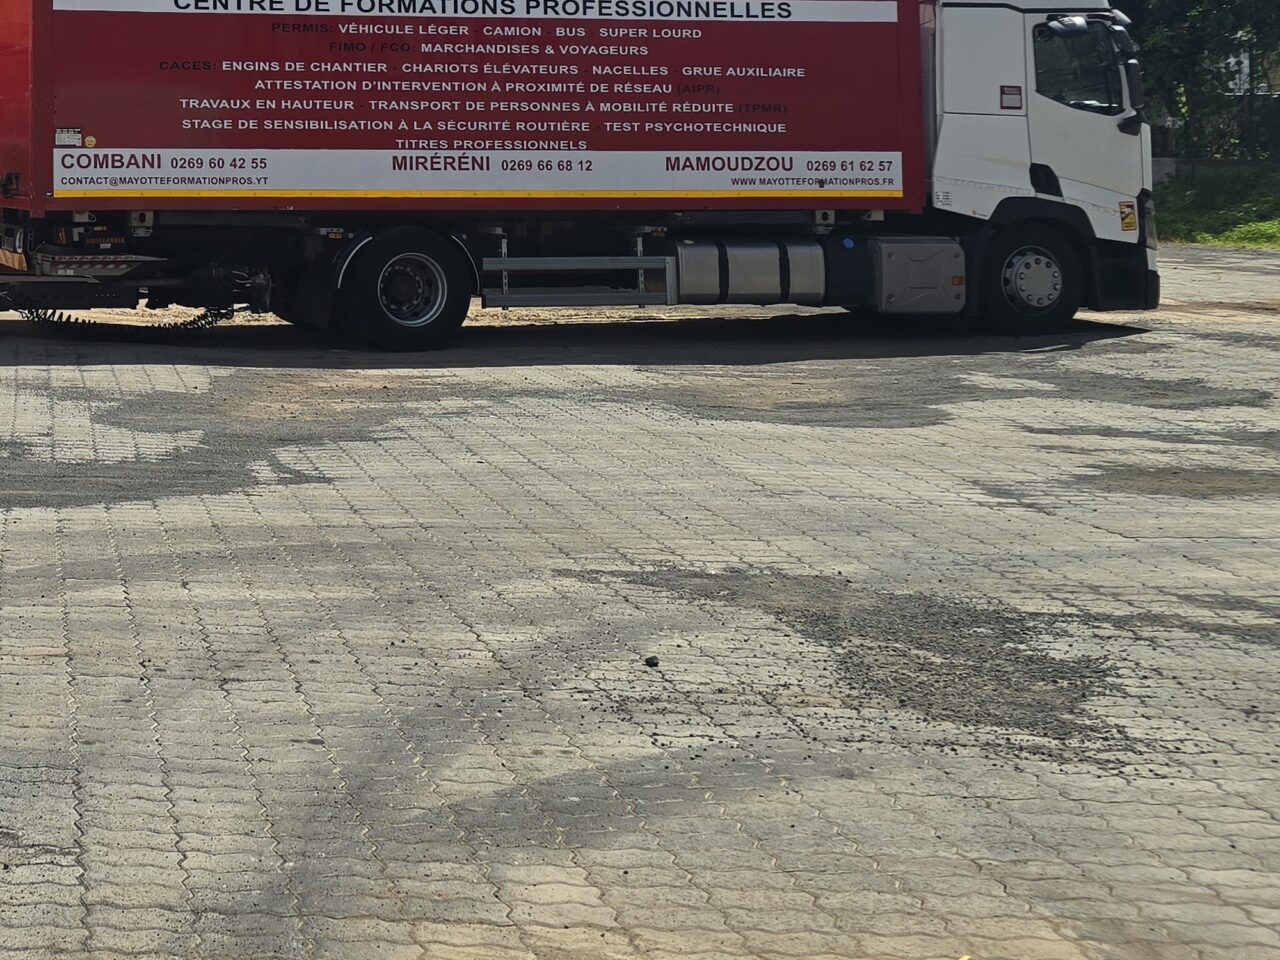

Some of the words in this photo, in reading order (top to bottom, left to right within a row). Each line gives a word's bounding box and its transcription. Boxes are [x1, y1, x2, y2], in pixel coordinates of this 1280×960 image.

[338, 22, 413, 34] VÉHICULE
[419, 24, 468, 35] LÉGER
[483, 26, 541, 35] CAMION
[556, 27, 585, 36] BUS
[600, 28, 647, 37] SUPER
[653, 29, 701, 37] LOURD
[421, 43, 539, 53] MARCHANDISES
[559, 45, 648, 55] VOYAGEURS
[222, 61, 279, 71] ENGINS
[285, 62, 304, 71] DE
[310, 62, 387, 72] CHANTIER
[402, 63, 478, 73] CHARIOTS
[484, 62, 578, 74] ÉLÉVATEURS
[592, 65, 668, 75] NACELLES
[682, 67, 722, 75] GRUE
[726, 67, 805, 76] AUXILIAIRE
[254, 80, 356, 90] ATTESTATION
[506, 81, 584, 92] PROXIMITÉ
[590, 83, 608, 92] DE
[614, 82, 671, 93] RÉSEAU
[179, 99, 250, 108] TRAVAUX
[256, 100, 275, 108] EN
[282, 100, 354, 109] HAUTEUR
[368, 100, 460, 110] TRANSPORT
[466, 101, 485, 110] DE
[490, 102, 580, 111] PERSONNES
[600, 101, 667, 111] MOBILITÉ
[672, 101, 733, 112] RÉDUITE
[182, 119, 232, 128] STAGE
[238, 120, 258, 129] DE
[264, 120, 392, 129] SENSIBILISATION
[414, 121, 432, 129] LA
[437, 120, 510, 130] SÉCURITÉ
[516, 120, 589, 131] ROUTIÈRE
[604, 122, 640, 131] TEST
[645, 123, 786, 132] PSYCHOTECHNIQUE
[396, 140, 448, 148] TITRES
[454, 140, 586, 149] PROFESSIONNELS
[61, 154, 161, 168] COMBANI
[171, 157, 203, 168] 0269
[209, 157, 224, 168] 60
[229, 157, 245, 168] 42
[251, 158, 266, 169] 55
[392, 152, 489, 170] MIRÉRÉNI
[501, 160, 532, 171] 0269
[538, 160, 552, 170] 66
[558, 160, 572, 171] 68
[578, 160, 592, 171] 12
[666, 156, 793, 171] MAMOUDZOU
[806, 160, 836, 171] 0269
[840, 160, 853, 171] 61
[860, 160, 874, 171] 62
[878, 161, 892, 171] 57
[61, 176, 268, 186] CONTACT@MAYOTTEFORMATIONPROS.YT
